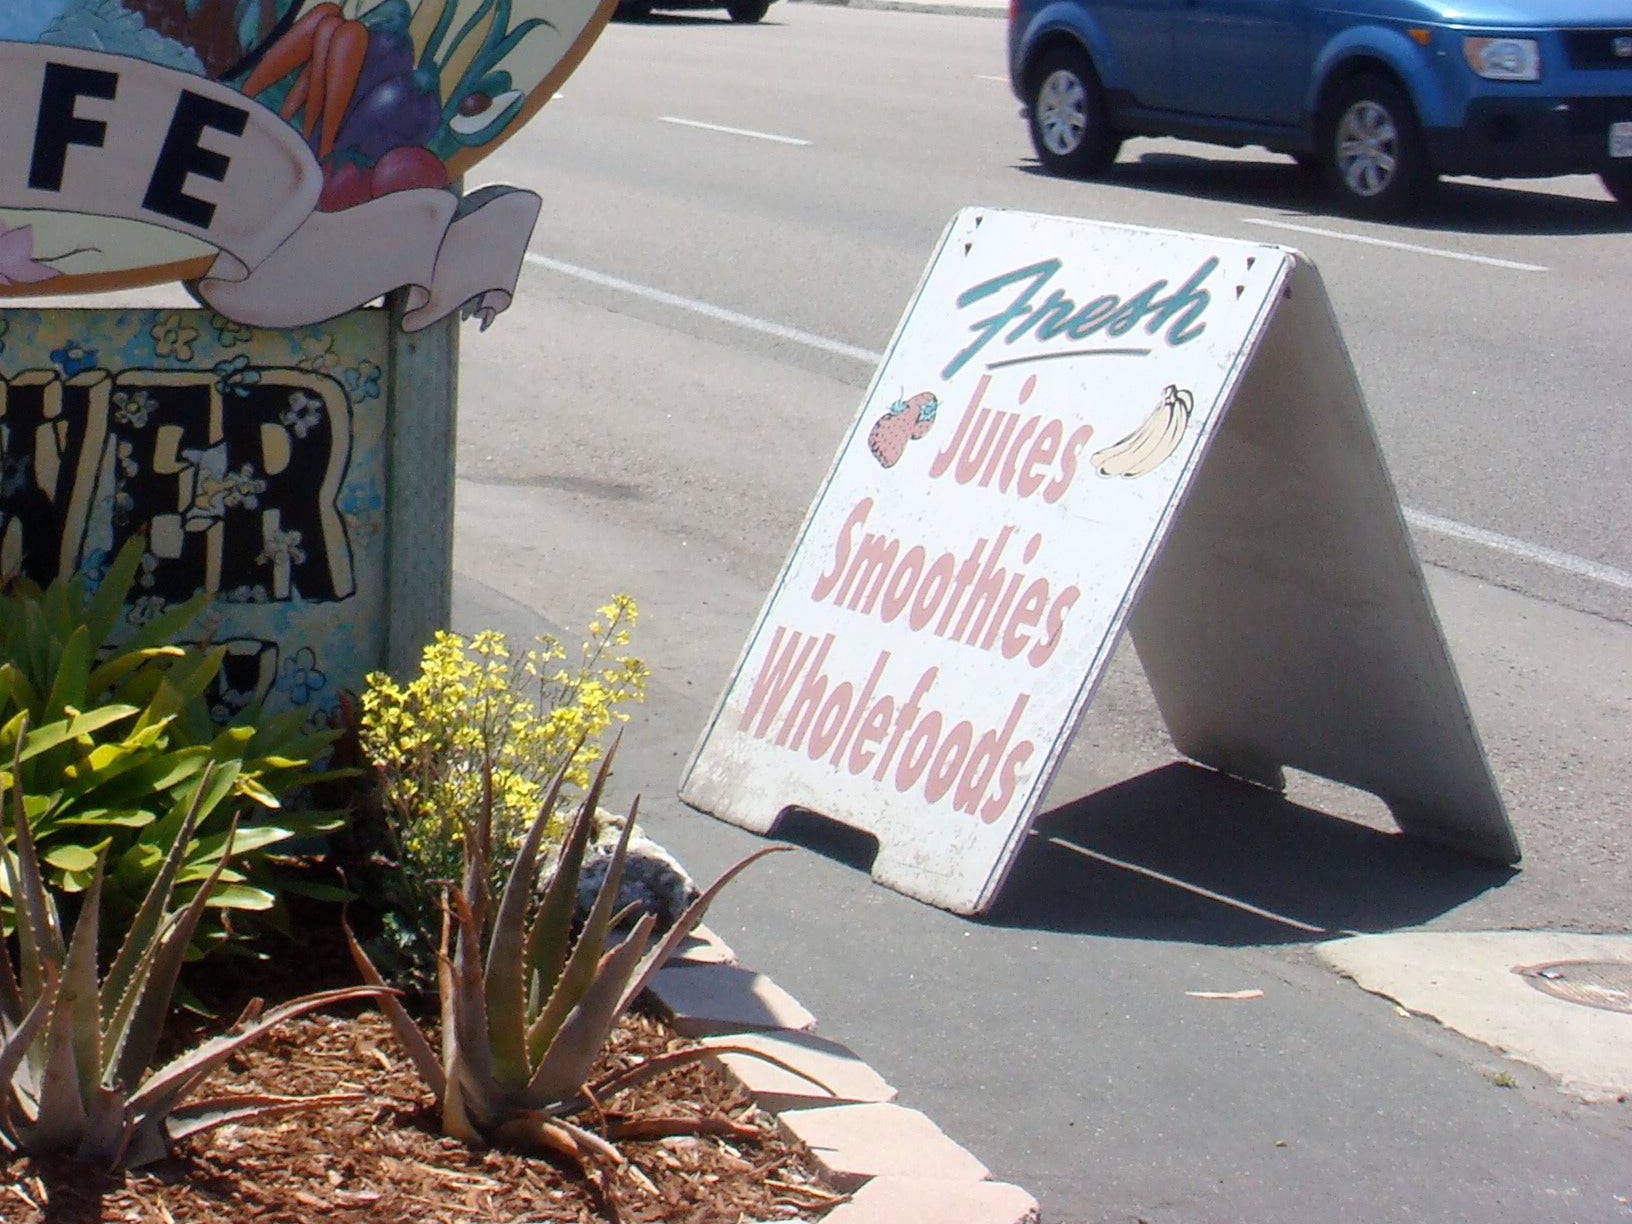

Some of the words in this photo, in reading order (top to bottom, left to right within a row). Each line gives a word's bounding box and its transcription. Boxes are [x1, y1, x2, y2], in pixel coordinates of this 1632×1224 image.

[940, 256, 1220, 381] Fresh
[928, 374, 1095, 505] Juices
[810, 497, 1082, 669] Smoothies
[736, 625, 1036, 825] Wholefoods
